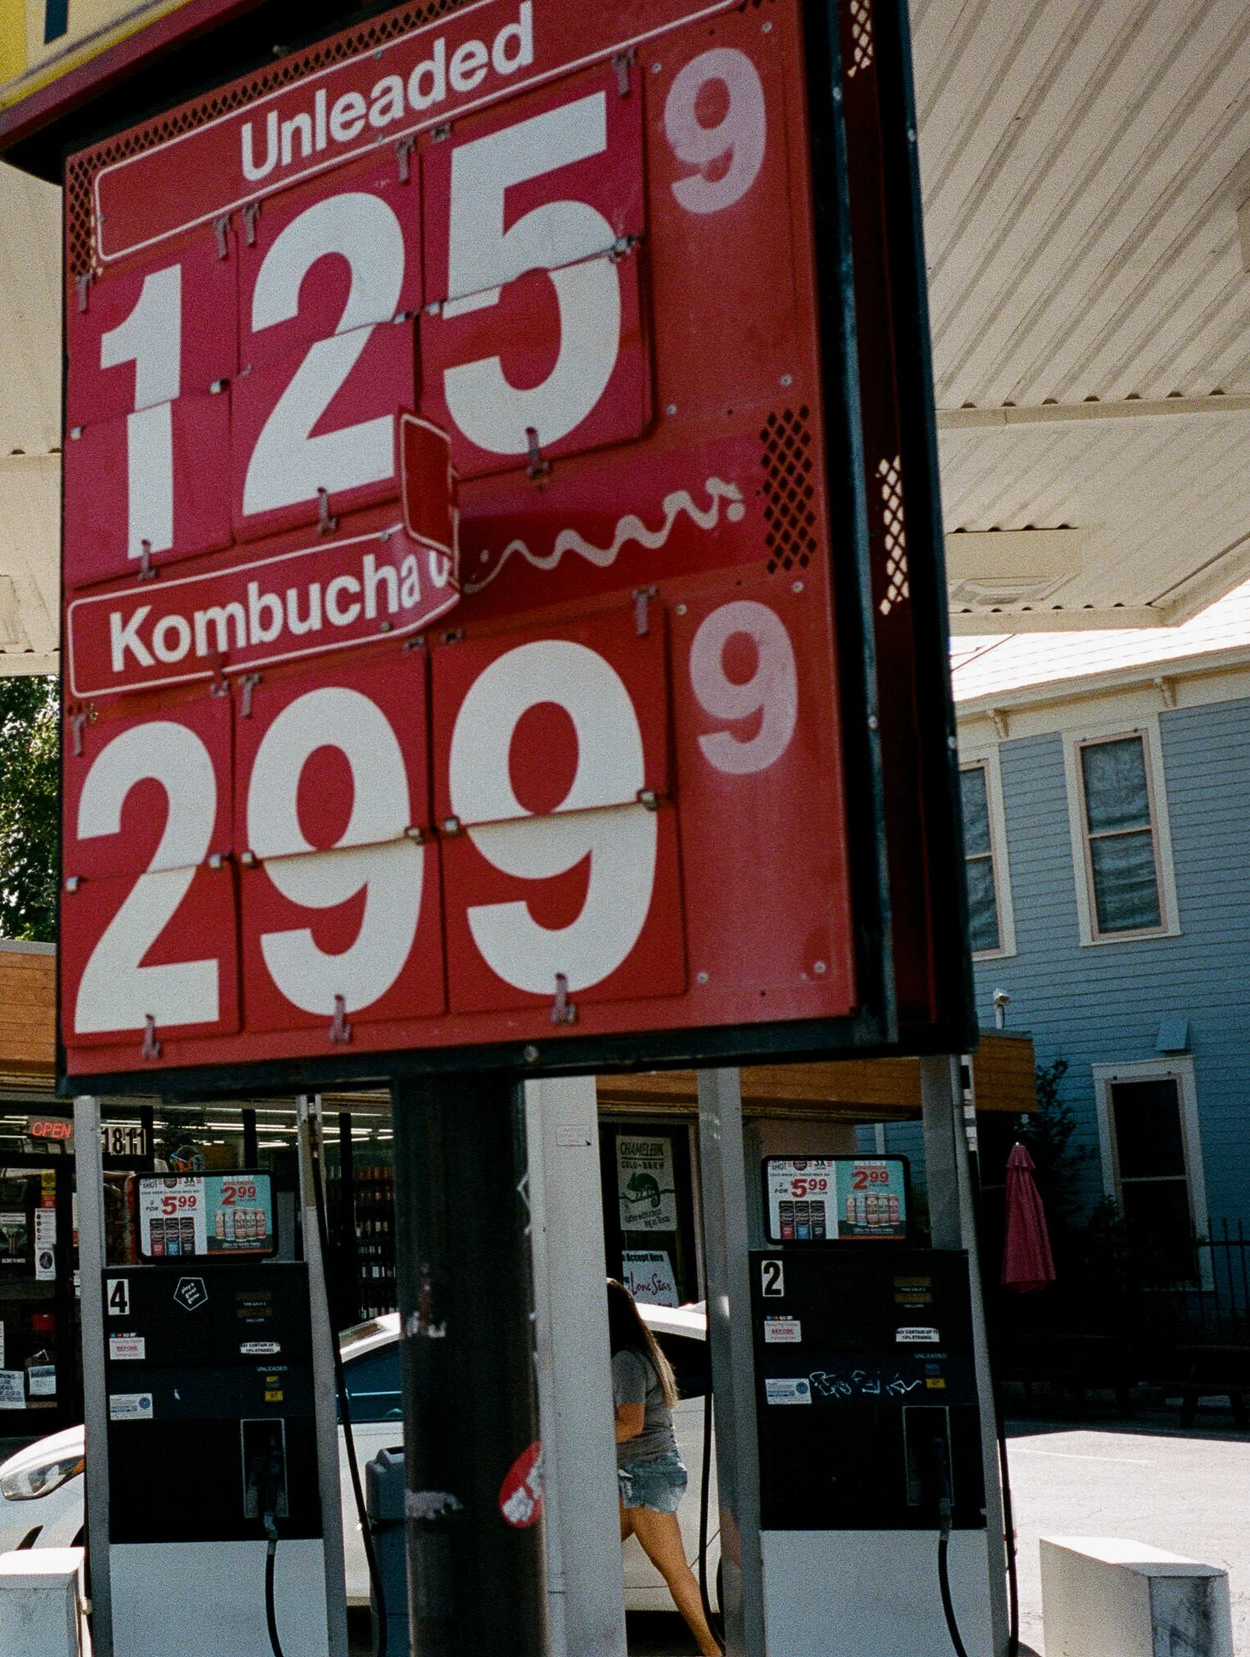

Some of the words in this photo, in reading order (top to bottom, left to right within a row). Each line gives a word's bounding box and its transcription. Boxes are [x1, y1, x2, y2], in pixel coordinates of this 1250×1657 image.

[241, 1, 535, 182] Unleaded
[664, 47, 768, 214] 9
[108, 553, 421, 673] Kombucha
[689, 600, 798, 774] 9
[32, 1122, 73, 1139] OPEN
[620, 1142, 664, 1157] CHAMELEON
[110, 1280, 128, 1313] 4
[763, 1261, 782, 1296] 2
